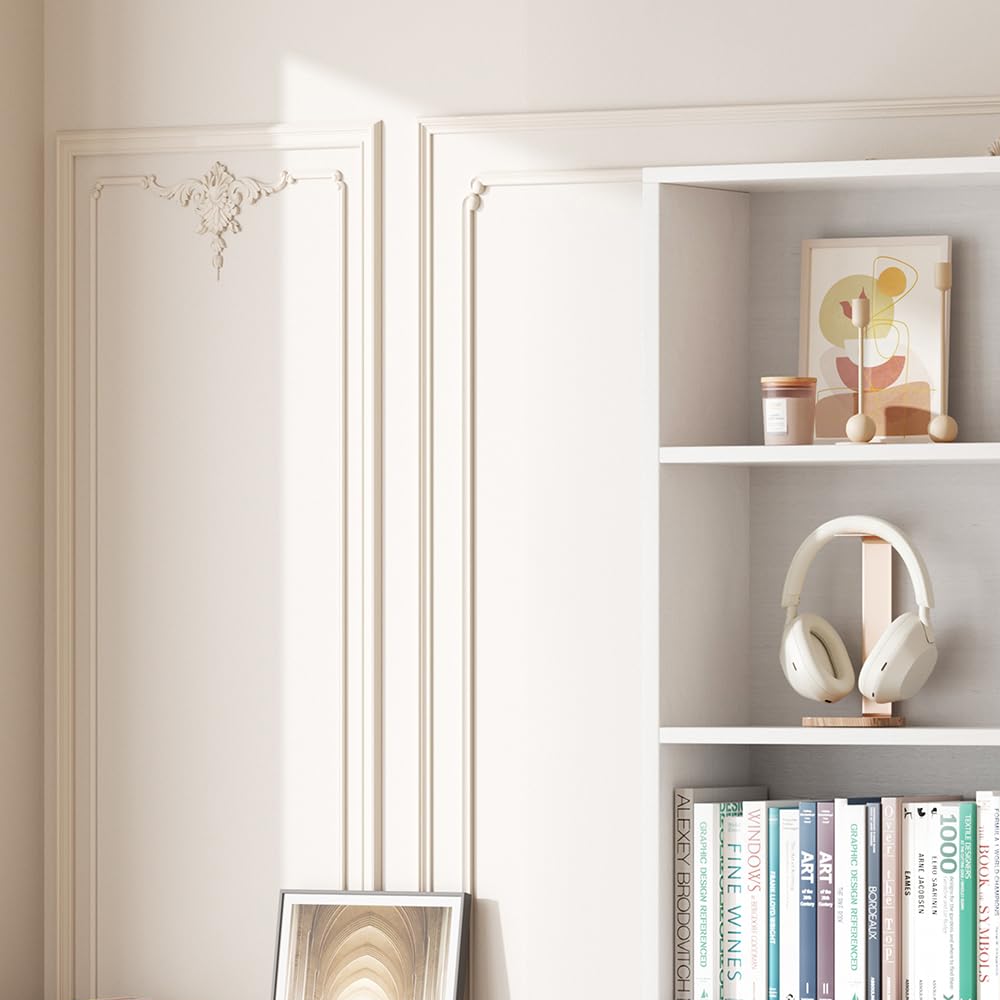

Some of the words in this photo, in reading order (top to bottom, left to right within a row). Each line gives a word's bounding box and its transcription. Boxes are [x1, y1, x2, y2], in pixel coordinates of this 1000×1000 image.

[677, 794, 691, 866] ALEXEY
[700, 822, 708, 864] GRAPHIC
[748, 809, 762, 892] WINDOWS
[850, 823, 858, 866] GRAPHIC
[940, 814, 957, 874] 1000
[700, 867, 708, 902] DESIGN
[728, 844, 742, 893] FINE
[801, 850, 815, 884] ART
[819, 851, 833, 885] ART
[850, 869, 858, 905] DESIGN
[979, 845, 990, 888] BOOK
[677, 872, 691, 992] BRODOVITCH
[700, 905, 708, 968] REFERENCED
[850, 908, 858, 971] REFERENCED
[868, 886, 878, 940] BORDEAUX
[728, 905, 742, 980] WINES
[979, 905, 990, 983] SYMBOLS
